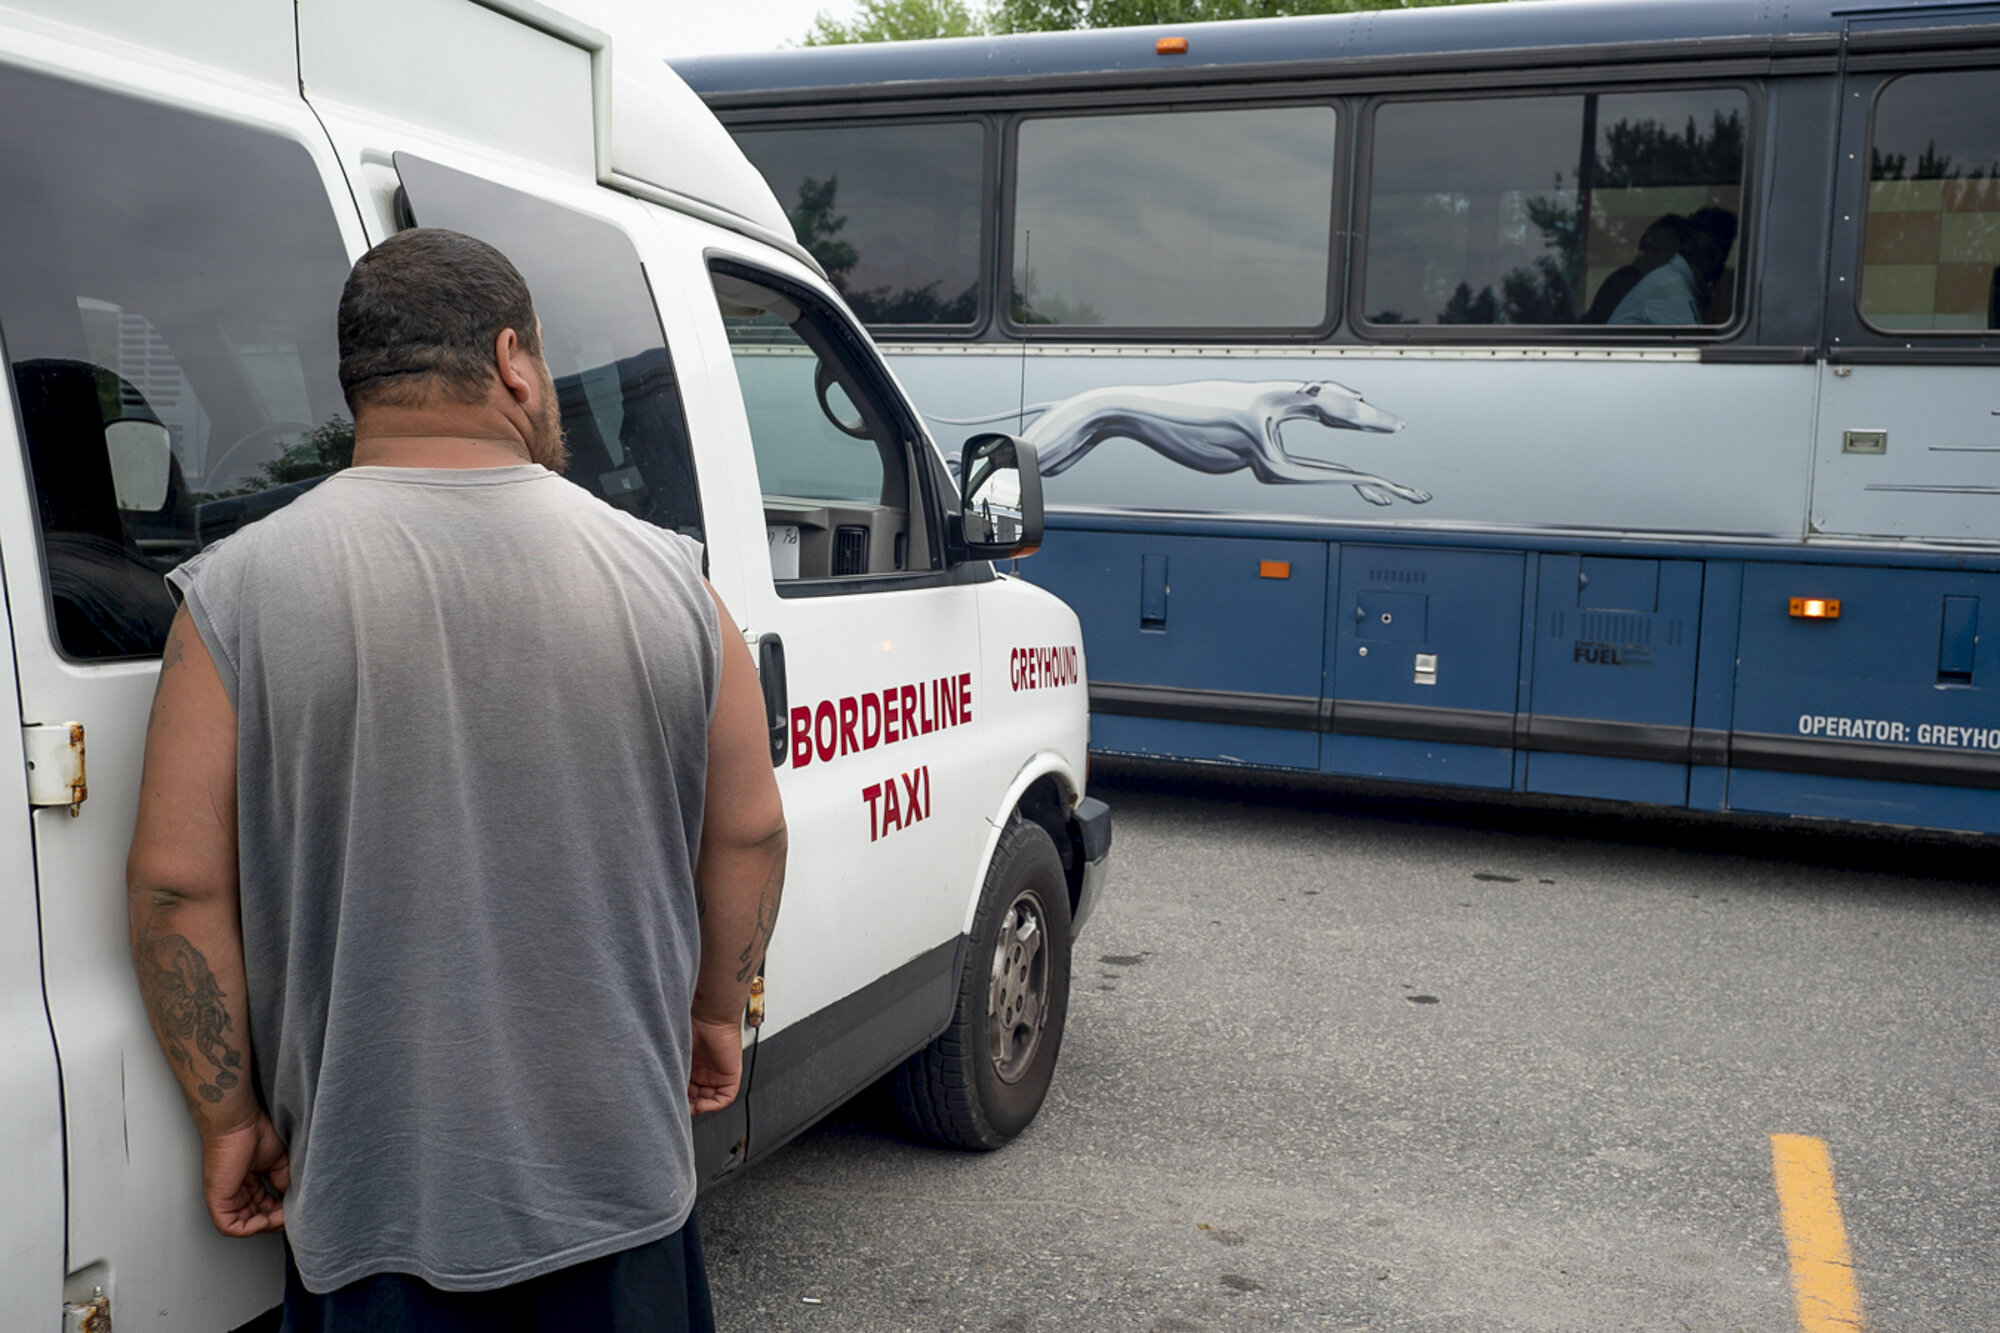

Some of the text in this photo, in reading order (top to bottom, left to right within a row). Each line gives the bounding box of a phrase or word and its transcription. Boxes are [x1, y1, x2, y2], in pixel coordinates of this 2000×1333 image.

[1010, 645, 1079, 692] GREYHOUND
[1574, 647, 1621, 665] FUEL
[790, 672, 972, 769] BORDERLINE
[1799, 715, 2000, 749] OPERATOR: GREYHO
[862, 765, 931, 842] TAXI
